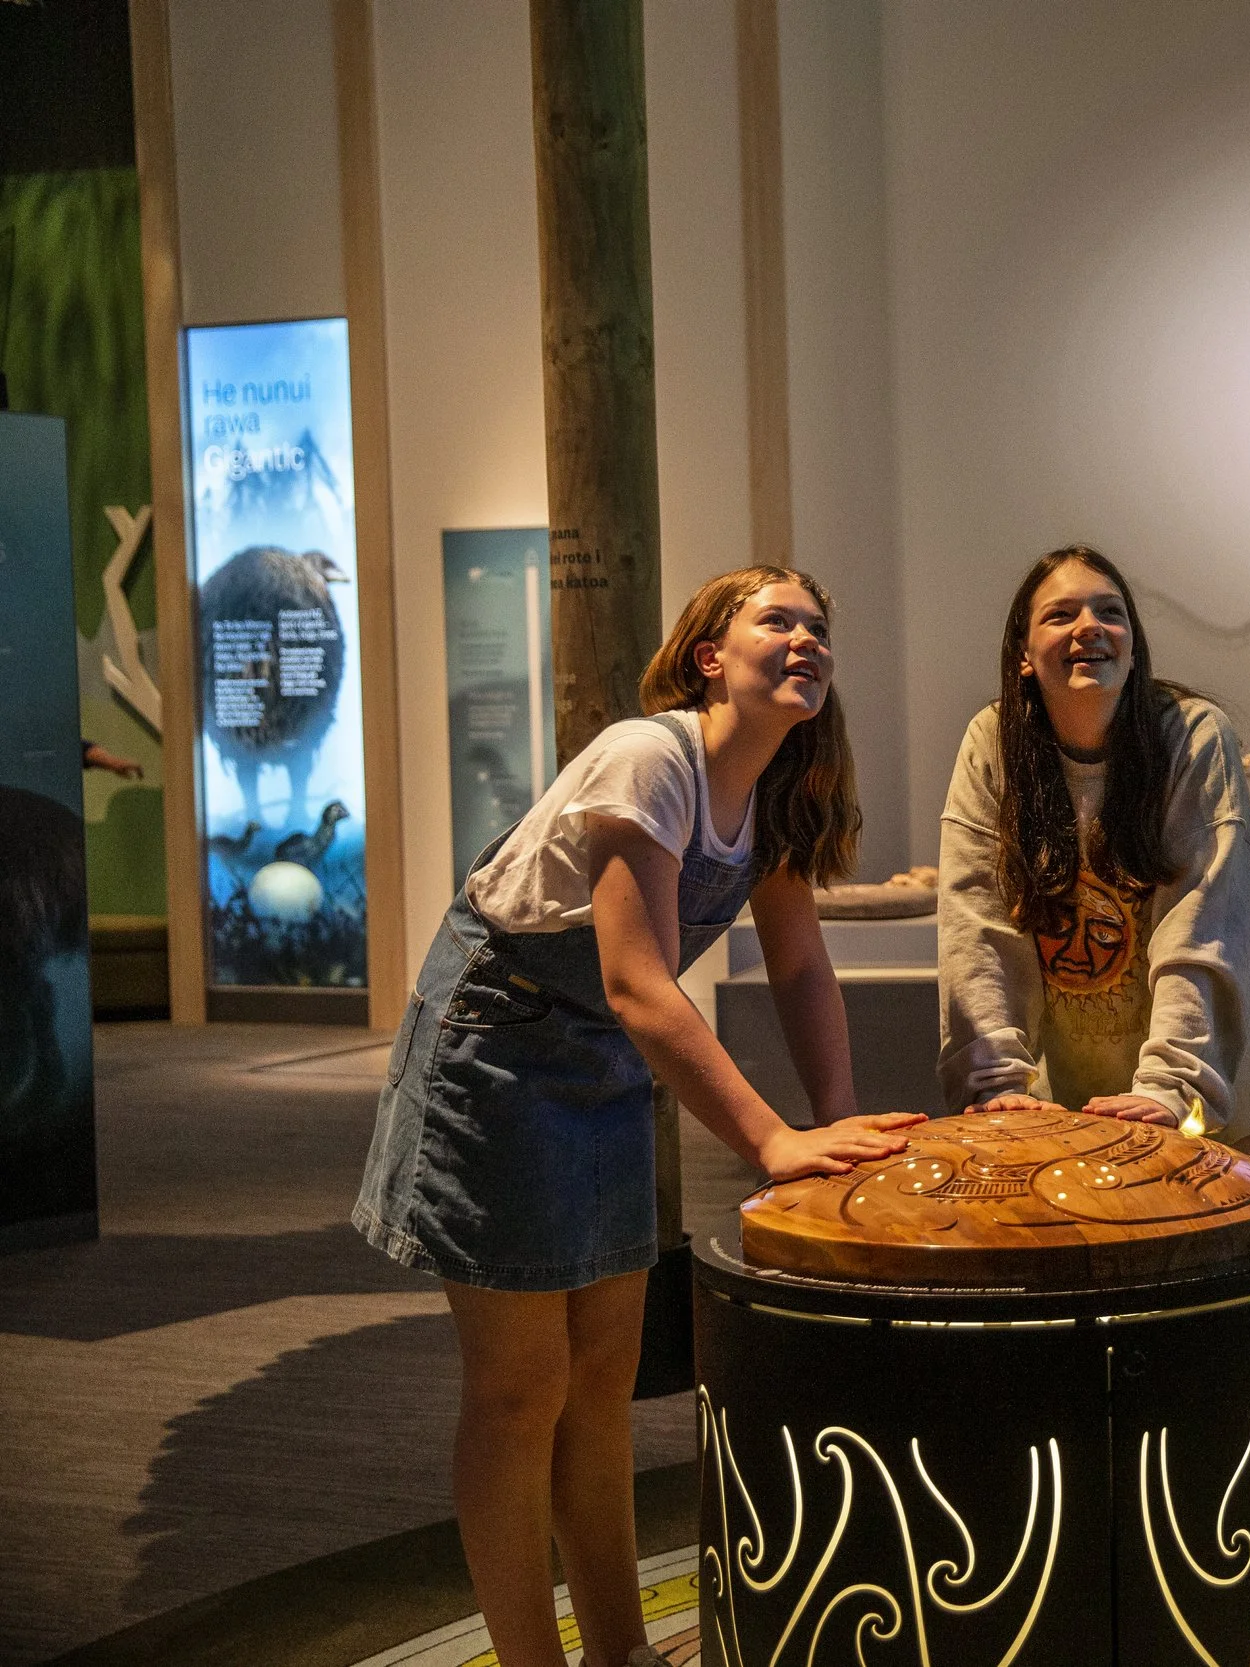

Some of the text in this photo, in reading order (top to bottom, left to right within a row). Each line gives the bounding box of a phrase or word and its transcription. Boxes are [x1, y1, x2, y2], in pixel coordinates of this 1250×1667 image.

[203, 372, 312, 406] He nunui
[203, 411, 261, 437] rawa
[203, 442, 306, 482] Gigantic
